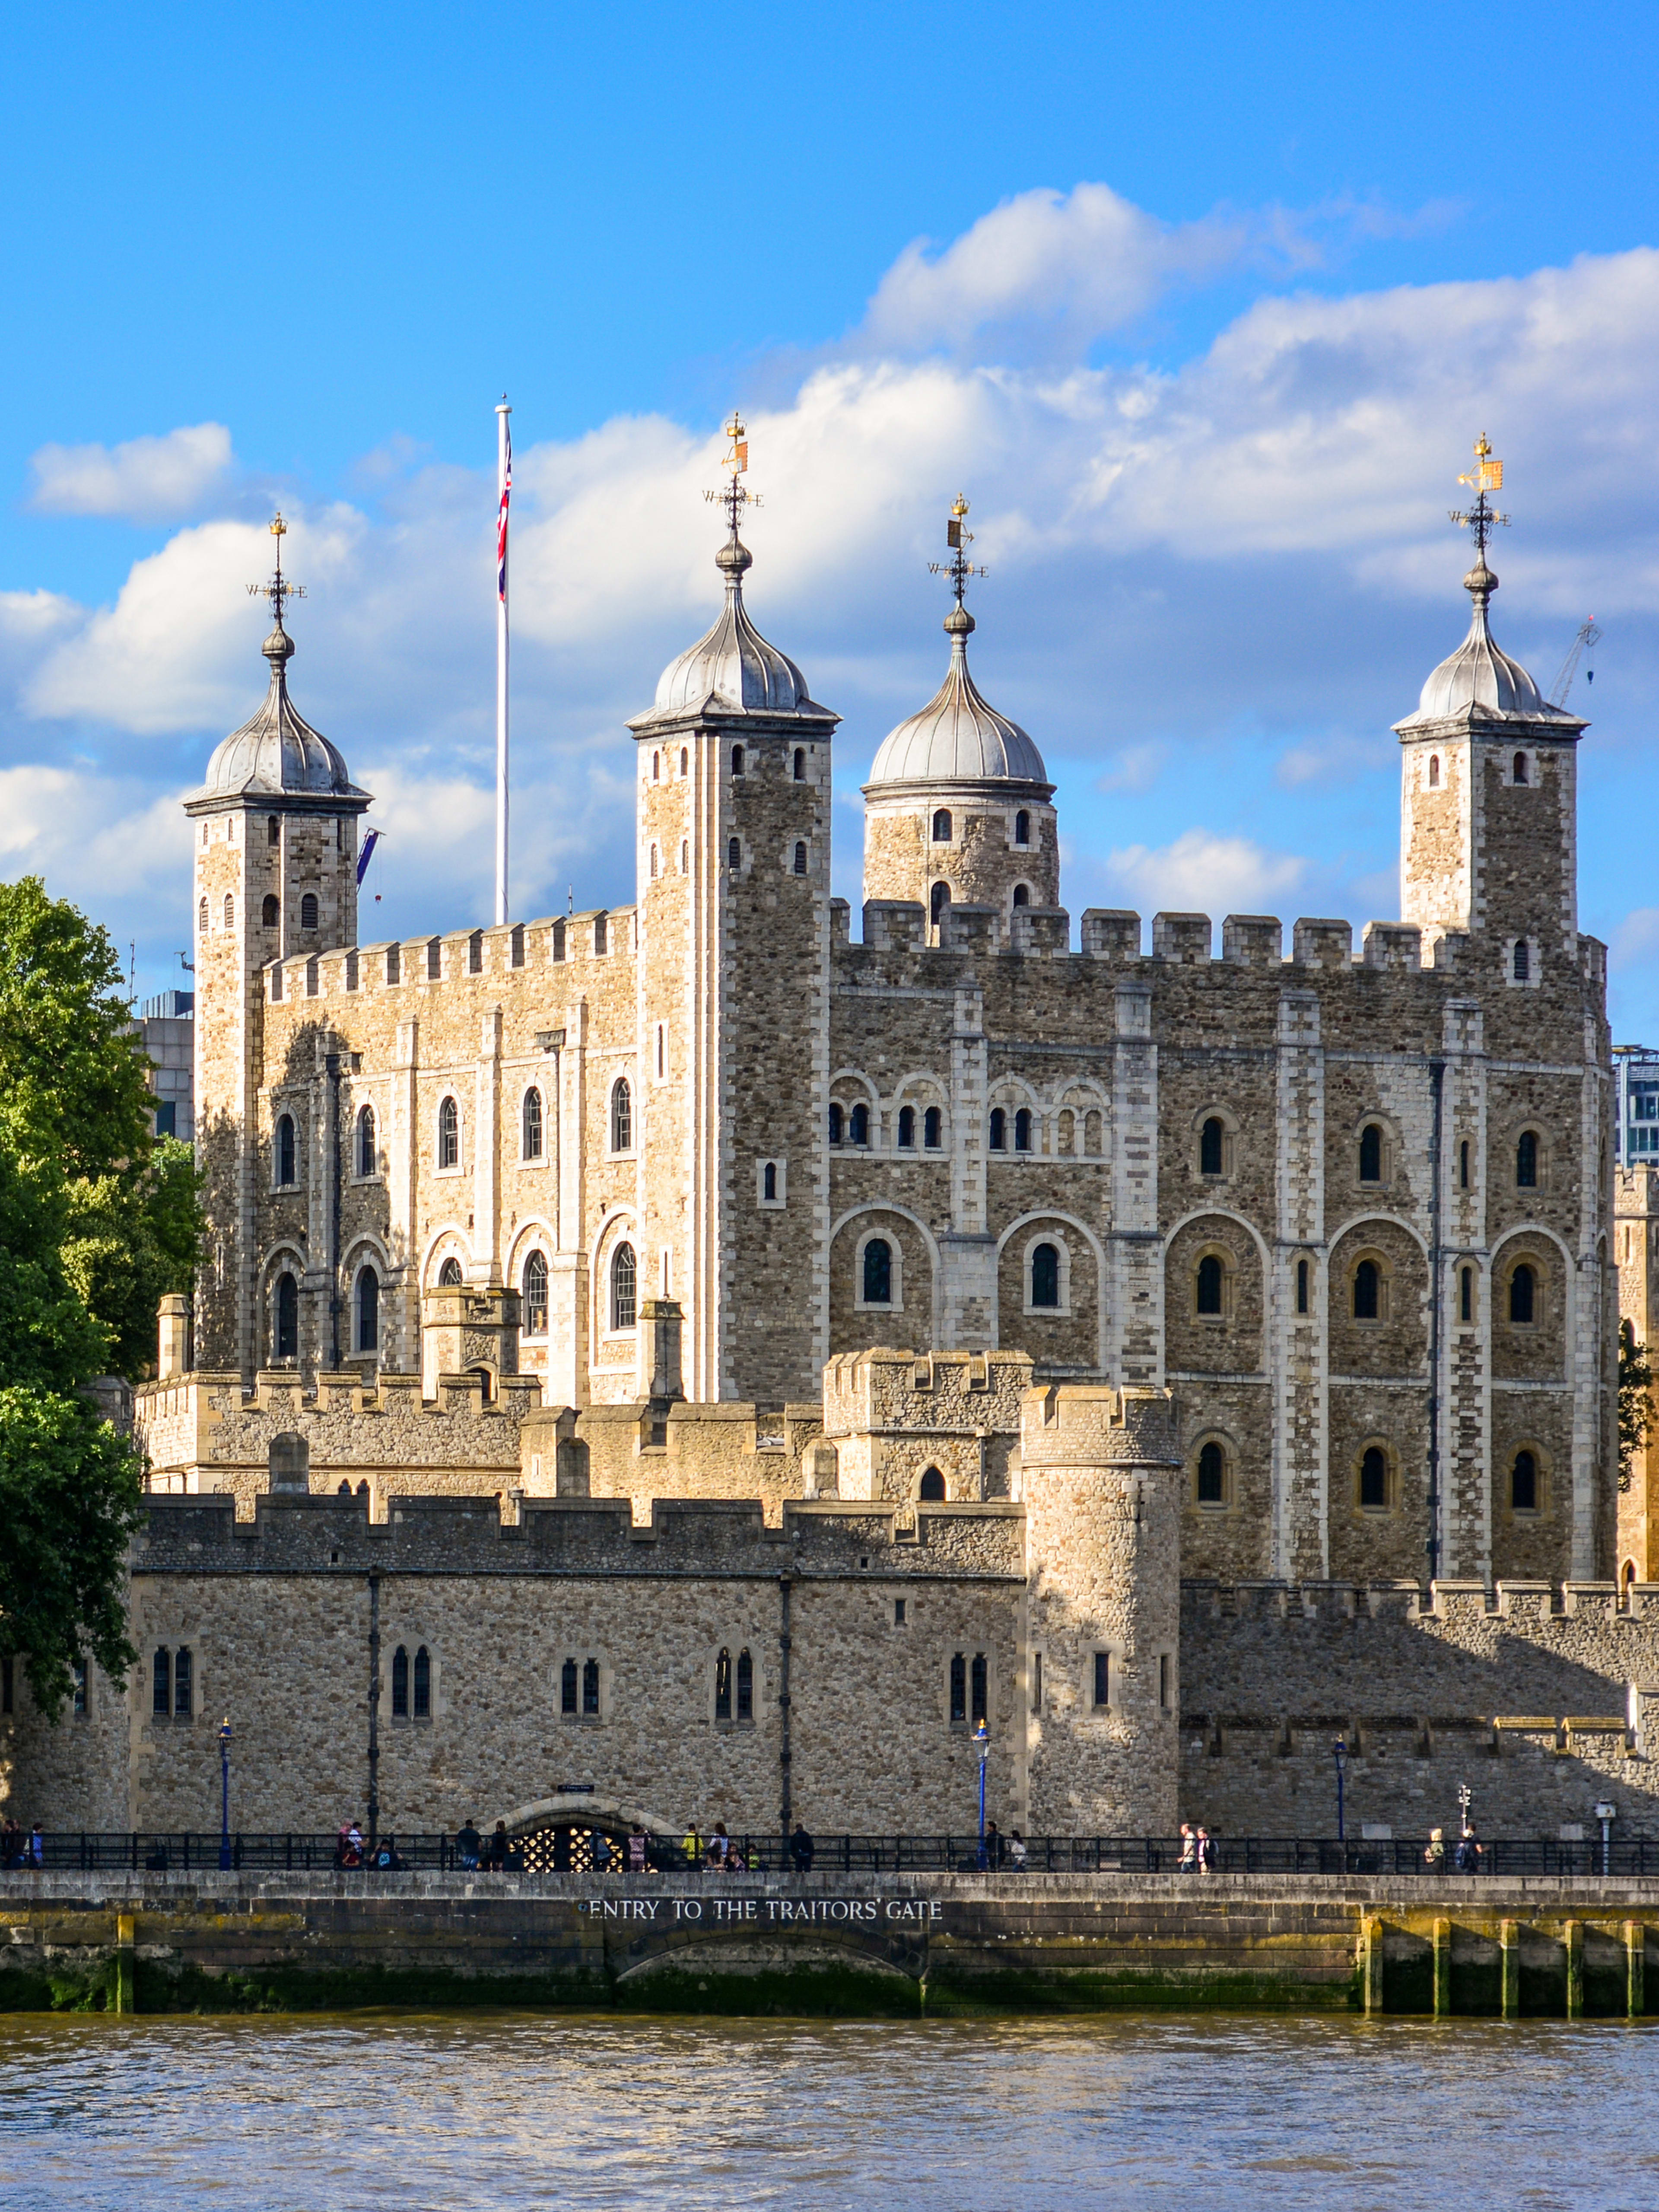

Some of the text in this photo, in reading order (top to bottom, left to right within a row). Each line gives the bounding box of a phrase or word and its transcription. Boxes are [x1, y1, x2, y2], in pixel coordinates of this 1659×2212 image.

[702, 490, 714, 502] W
[756, 495, 764, 507] E
[1449, 511, 1460, 522] W
[1503, 515, 1511, 527] E
[928, 563, 939, 574] W
[981, 567, 989, 578] E
[245, 585, 258, 596] W
[299, 587, 308, 598] E
[589, 1901, 659, 1920] ENTRY
[672, 1901, 702, 1919] TO
[713, 1901, 757, 1920] THE
[886, 1901, 943, 1920] GATE
